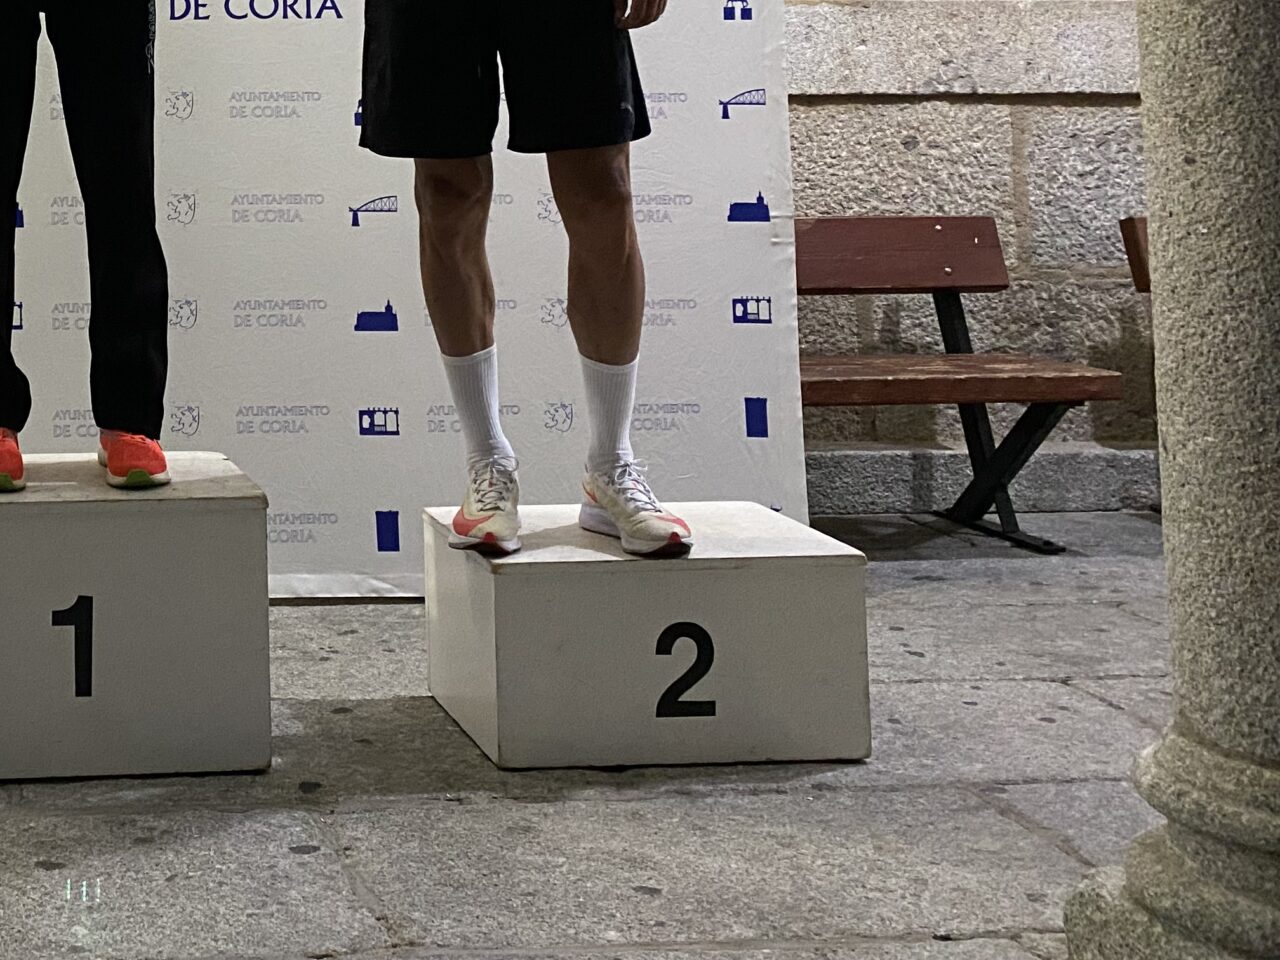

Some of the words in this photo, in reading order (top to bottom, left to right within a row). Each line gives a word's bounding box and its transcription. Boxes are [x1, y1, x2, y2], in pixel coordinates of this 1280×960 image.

[229, 91, 322, 102] AYUNTAMIENTO
[230, 105, 248, 119] DE
[250, 105, 301, 119] CORIA
[231, 194, 325, 205] AYUNTAMIENTO
[232, 209, 250, 223] DE
[252, 209, 303, 223] CORIA
[233, 300, 327, 311] AYUNTAMIENTO
[234, 315, 252, 328] DE
[255, 314, 306, 328] CORIA
[236, 405, 330, 417] AYUNTAMIENTO
[53, 424, 73, 438] DE
[237, 420, 255, 434] DE
[258, 420, 309, 434] CORIA
[51, 594, 94, 697] 1
[655, 621, 717, 718] 2
